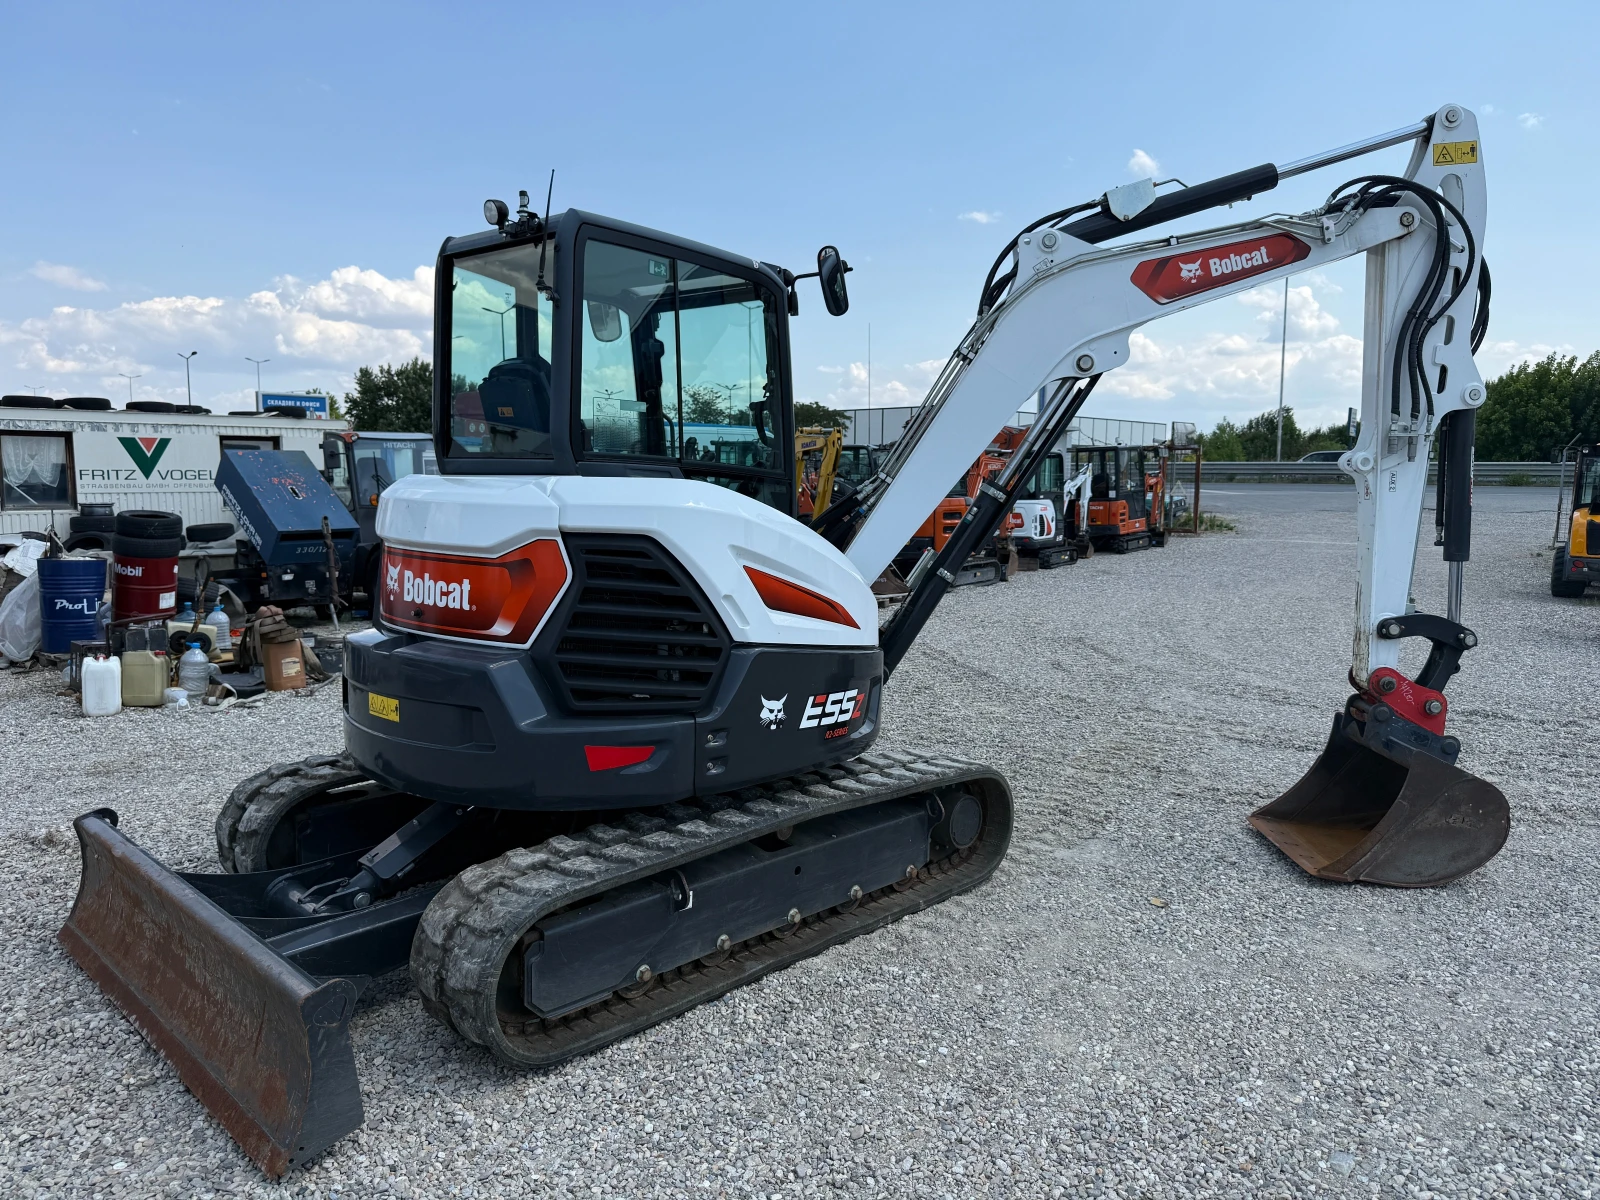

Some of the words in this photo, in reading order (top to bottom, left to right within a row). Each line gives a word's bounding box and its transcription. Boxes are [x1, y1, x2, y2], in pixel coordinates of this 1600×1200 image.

[1209, 246, 1269, 277] Bobcat
[79, 469, 137, 480] FRITZ
[157, 469, 216, 480] VOGEL
[114, 562, 143, 577] Mobil
[404, 569, 470, 611] Bobcat
